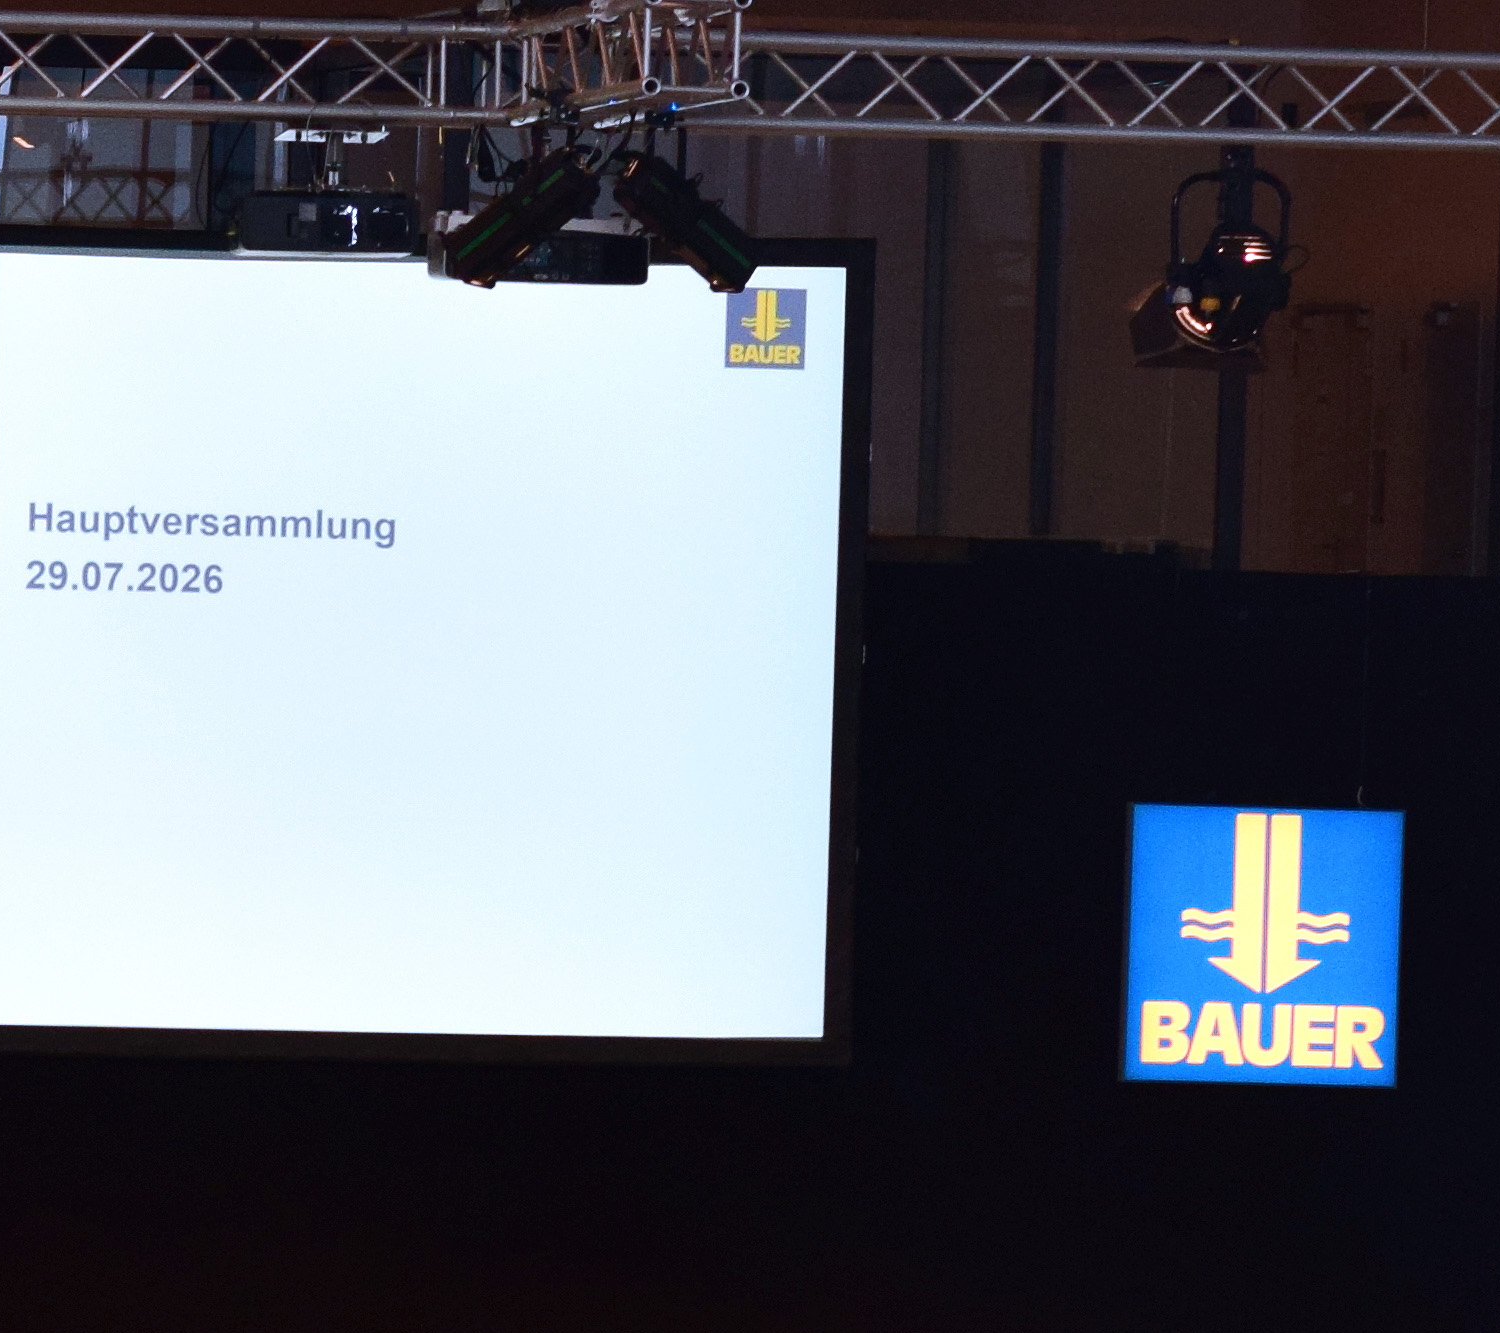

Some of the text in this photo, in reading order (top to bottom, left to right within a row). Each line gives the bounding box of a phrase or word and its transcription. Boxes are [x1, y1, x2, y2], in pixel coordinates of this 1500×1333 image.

[728, 343, 801, 366] BAUER
[28, 503, 397, 549] Hauptversammlung
[26, 560, 225, 596] 29.07.2026
[1140, 1000, 1386, 1069] BAUER
